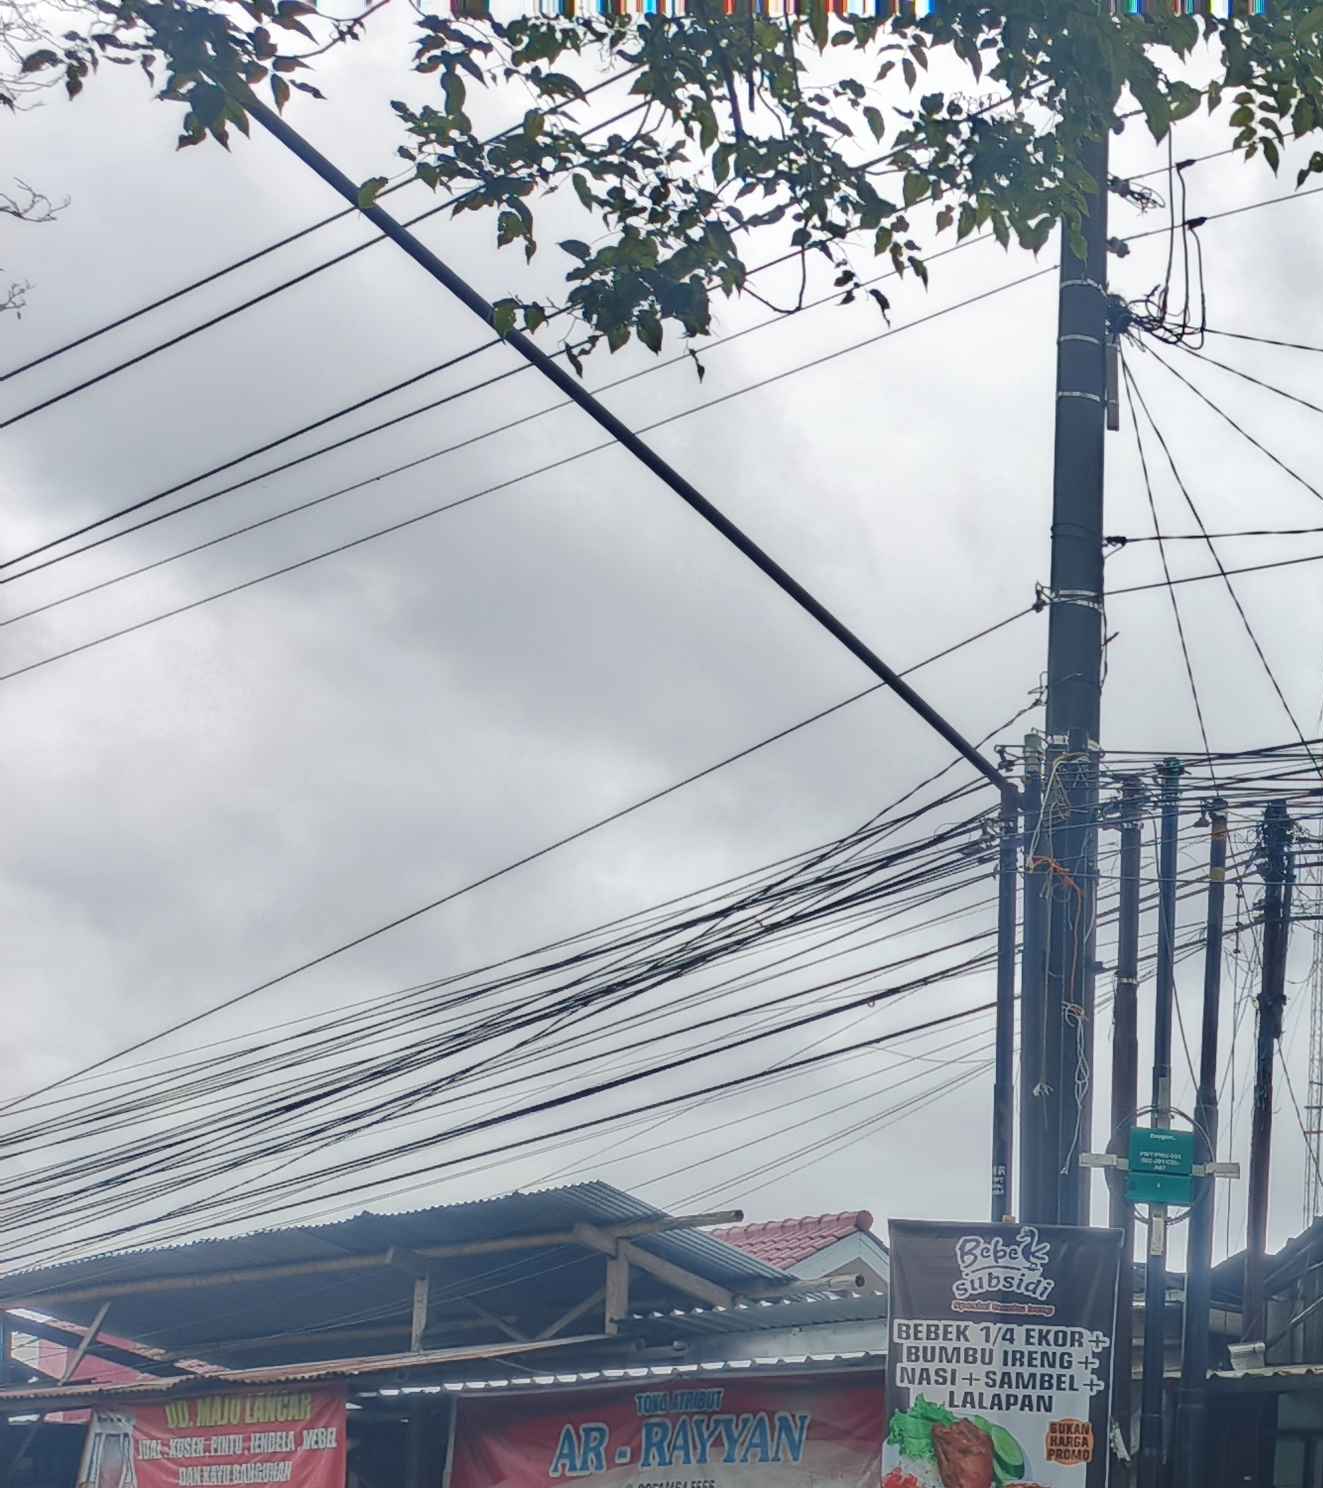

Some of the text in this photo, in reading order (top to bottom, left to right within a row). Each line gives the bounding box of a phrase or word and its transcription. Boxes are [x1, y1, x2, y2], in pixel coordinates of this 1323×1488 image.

[896, 1322, 970, 1342] BEBEK
[979, 1324, 1016, 1347] 1/4
[1024, 1328, 1084, 1348] EKOR
[905, 1345, 994, 1366] BUMBU
[1002, 1349, 1074, 1370] IRENG
[899, 1366, 957, 1387] NASI
[984, 1370, 1079, 1392] SAMBEL
[948, 1390, 1053, 1413] LALAPAN
[550, 1423, 608, 1477] AR
[638, 1411, 812, 1468] RAYYAN
[1050, 1435, 1089, 1448] HARGA
[1047, 1449, 1091, 1462] PROMO
